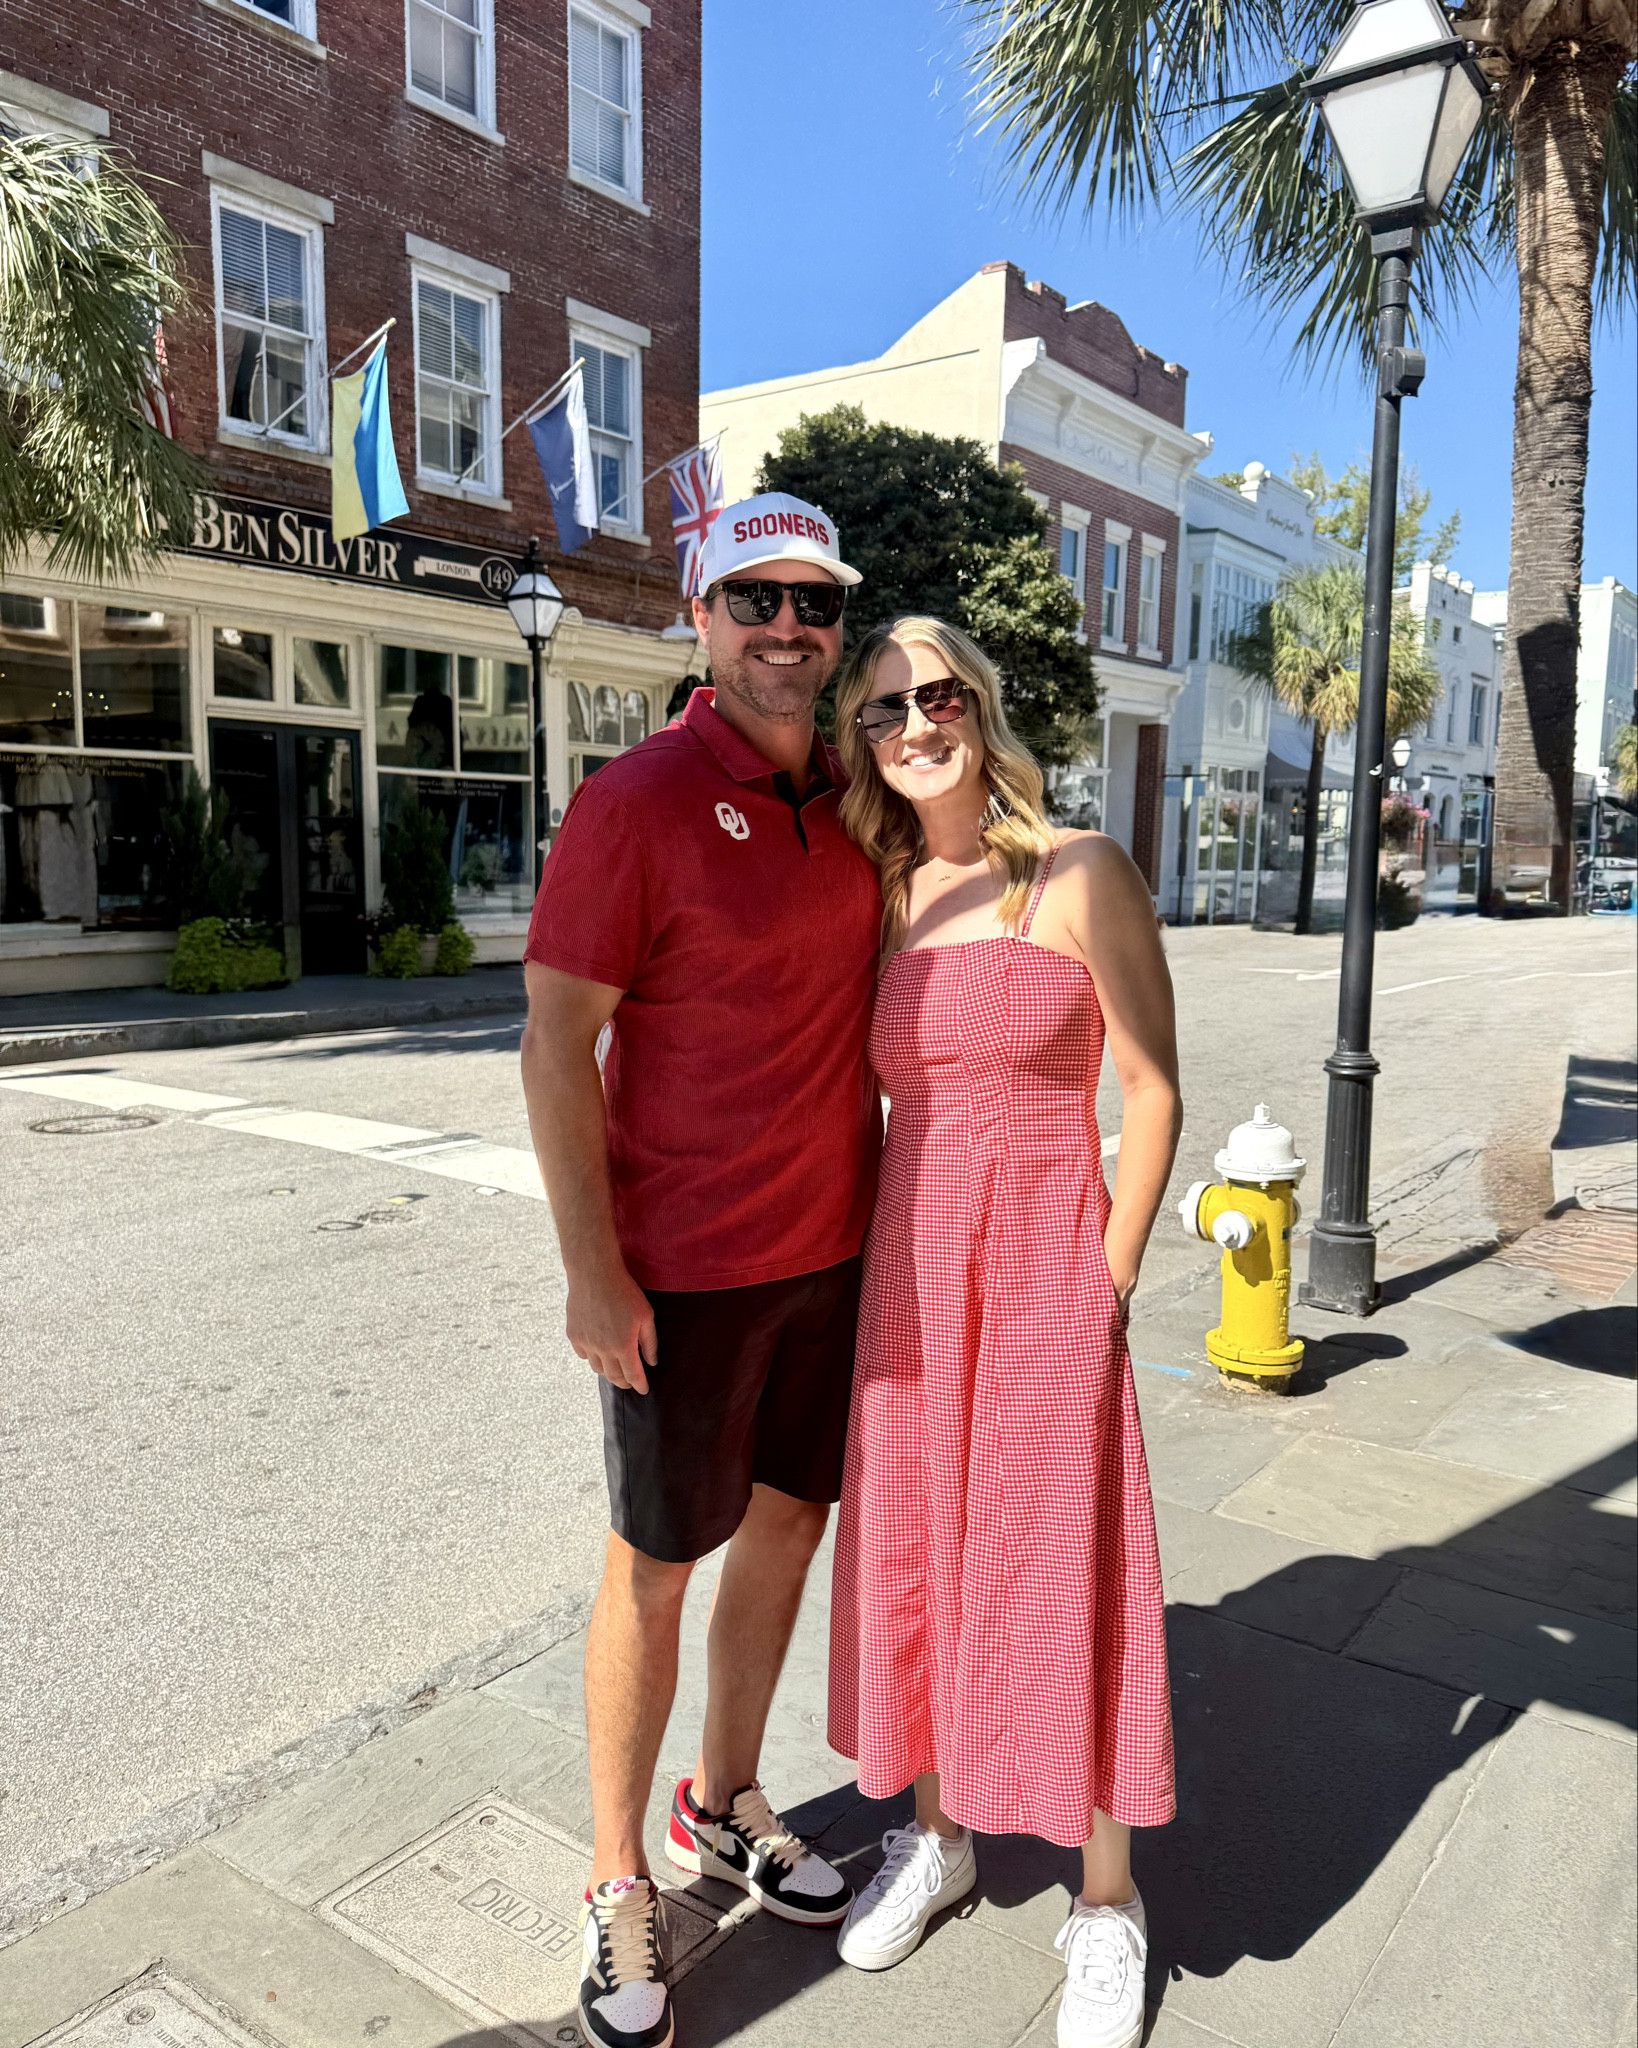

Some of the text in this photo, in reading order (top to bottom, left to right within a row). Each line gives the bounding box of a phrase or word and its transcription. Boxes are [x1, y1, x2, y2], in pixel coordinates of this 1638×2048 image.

[190, 493, 271, 559] BEN
[733, 512, 830, 546] SOONERS
[436, 562, 472, 577] LONDON
[486, 565, 513, 593] 149
[714, 802, 750, 840] OU
[472, 1887, 577, 1953] ELECTRIC
